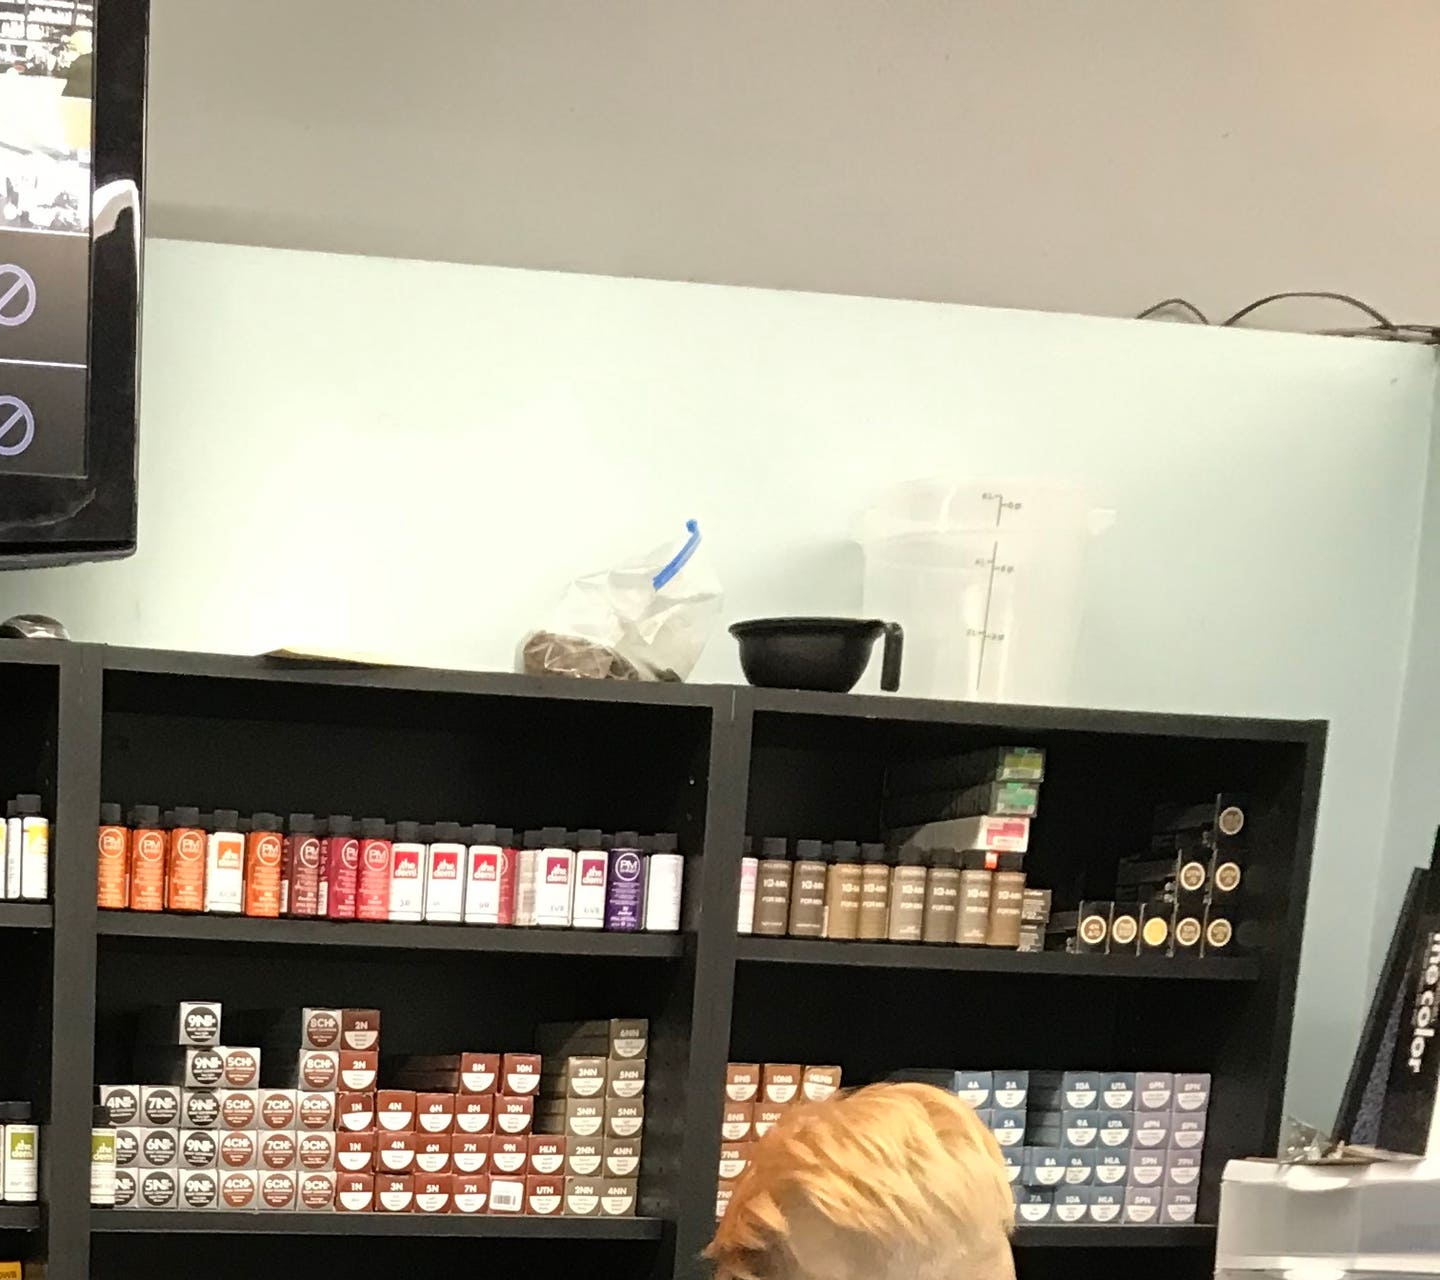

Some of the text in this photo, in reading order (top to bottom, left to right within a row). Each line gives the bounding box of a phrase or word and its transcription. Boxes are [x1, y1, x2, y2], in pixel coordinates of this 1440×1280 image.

[355, 1022, 368, 1030] 2N
[1408, 990, 1435, 1073] color
[353, 1061, 366, 1069] 2N
[516, 1065, 532, 1073] 10N
[352, 1104, 362, 1112] 1N
[388, 1102, 402, 1111] 4N
[430, 1105, 442, 1113] 6N
[507, 1105, 523, 1113] 10N
[350, 1143, 360, 1151] 1N
[392, 1142, 404, 1150] 4N
[426, 1144, 439, 1152] 6N
[464, 1143, 476, 1152] 7N
[504, 1144, 516, 1152] 9N
[351, 1183, 362, 1191] 1N
[391, 1182, 403, 1191] 3N
[426, 1185, 439, 1193] 5N
[465, 1185, 477, 1193] 7N
[537, 1186, 554, 1195] UTN
